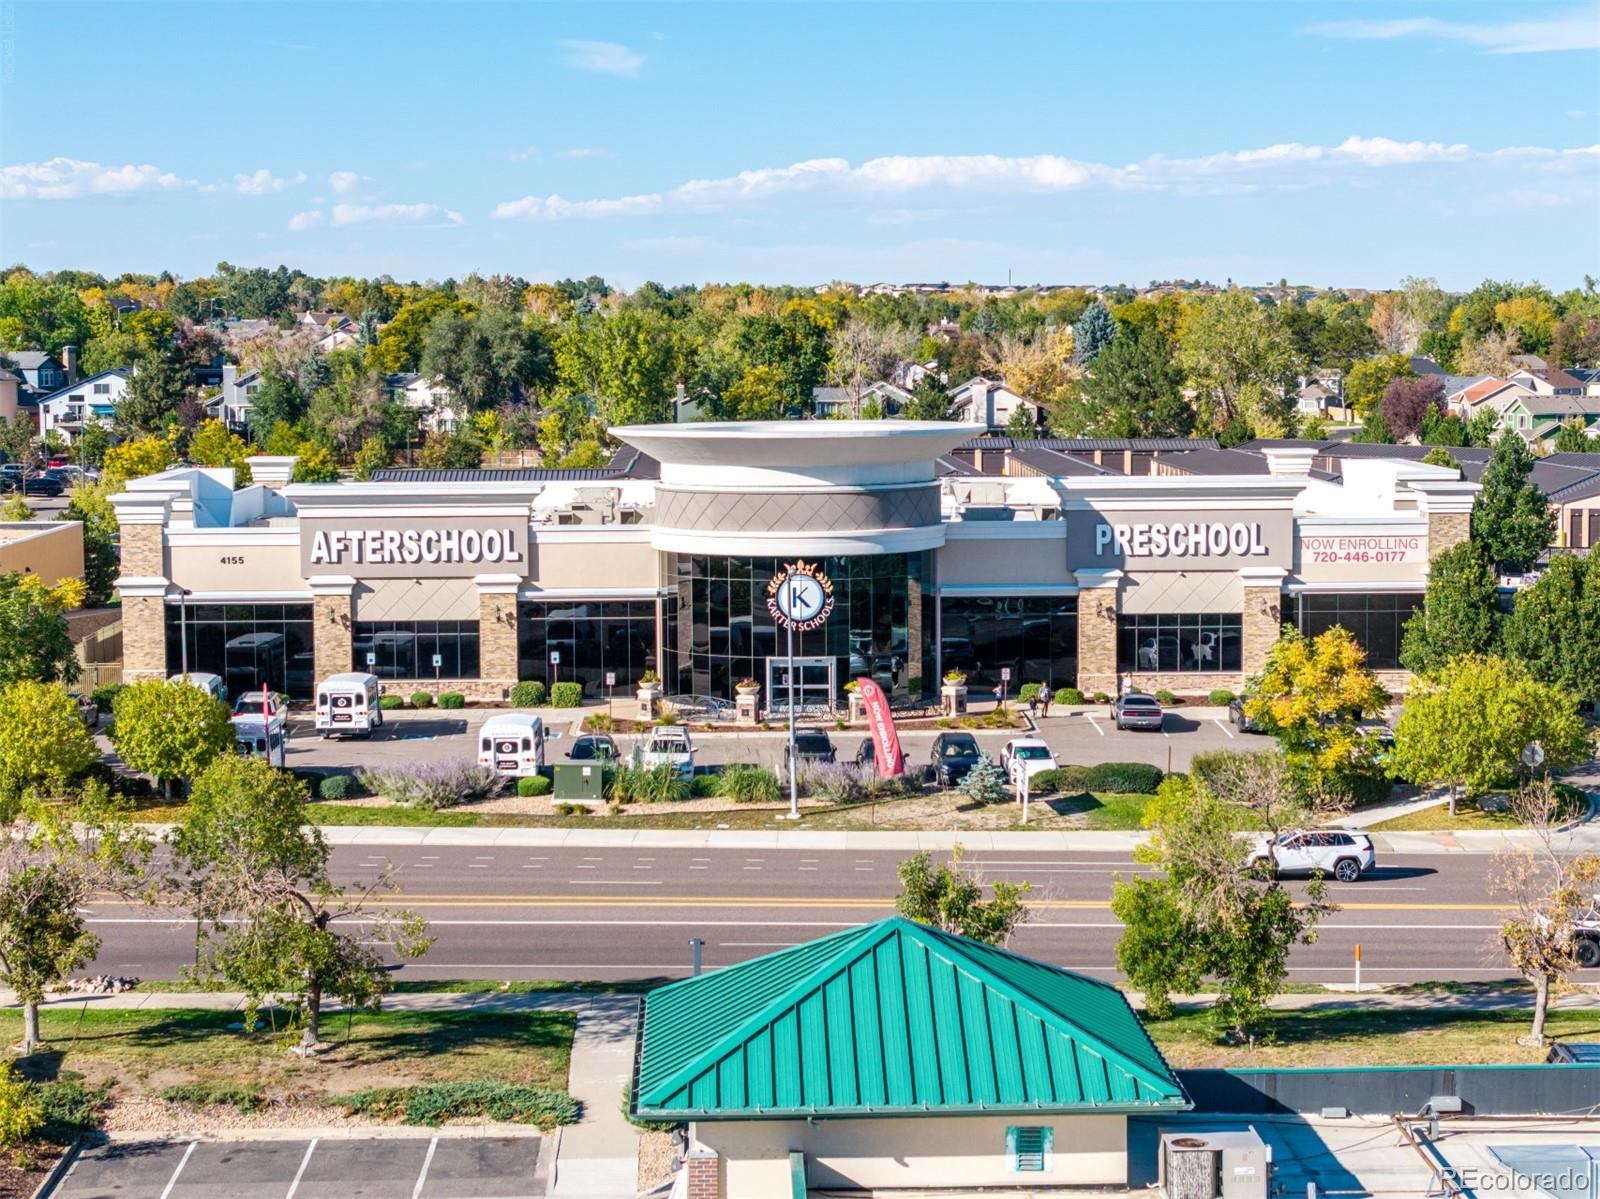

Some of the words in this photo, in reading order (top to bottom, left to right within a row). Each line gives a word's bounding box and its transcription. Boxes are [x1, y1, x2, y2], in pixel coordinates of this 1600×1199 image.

[310, 528, 523, 564] AFTERSCHOOL
[1095, 522, 1269, 557] PRESCHOOL
[1301, 538, 1335, 550] NOW
[1339, 538, 1419, 550] ENROLLING
[220, 556, 244, 564] 4155
[1313, 551, 1406, 562] 720-446-0177
[792, 586, 811, 608] K
[798, 595, 834, 632] SCHOOLS
[871, 701, 883, 722] NOW
